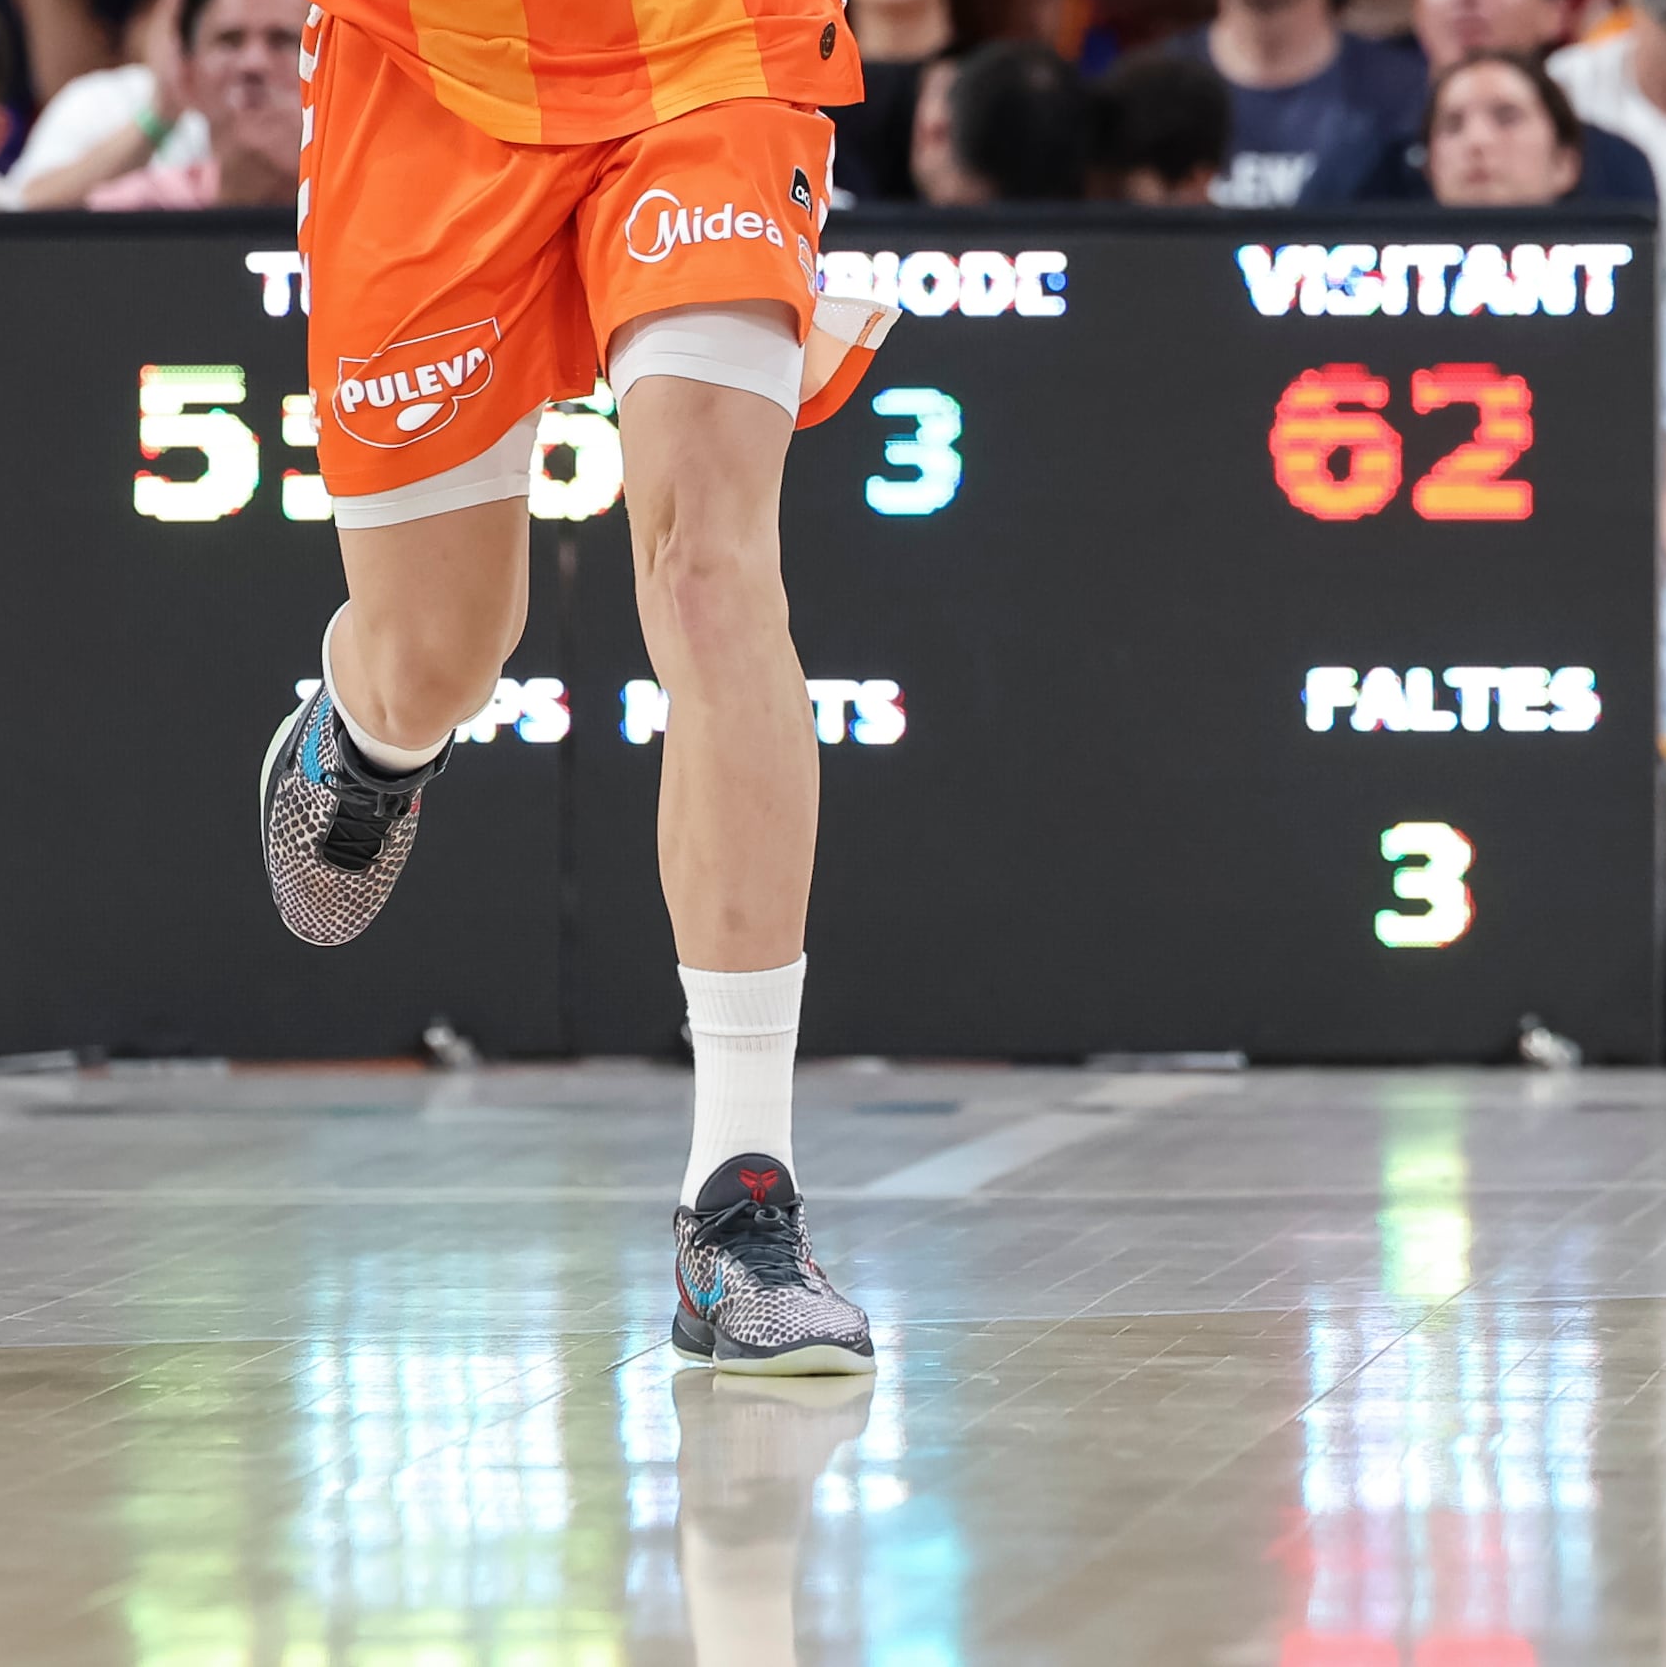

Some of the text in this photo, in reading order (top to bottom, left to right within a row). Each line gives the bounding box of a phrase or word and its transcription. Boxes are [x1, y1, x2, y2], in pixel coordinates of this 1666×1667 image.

[625, 188, 783, 263] Midea
[816, 251, 1068, 317] RIODE
[1234, 244, 1633, 316] VISITANT
[340, 347, 486, 414] PULEVA
[865, 388, 963, 515] 3
[1268, 363, 1534, 521] 62
[1300, 666, 1601, 732] FALTES
[1375, 822, 1476, 948] 3
